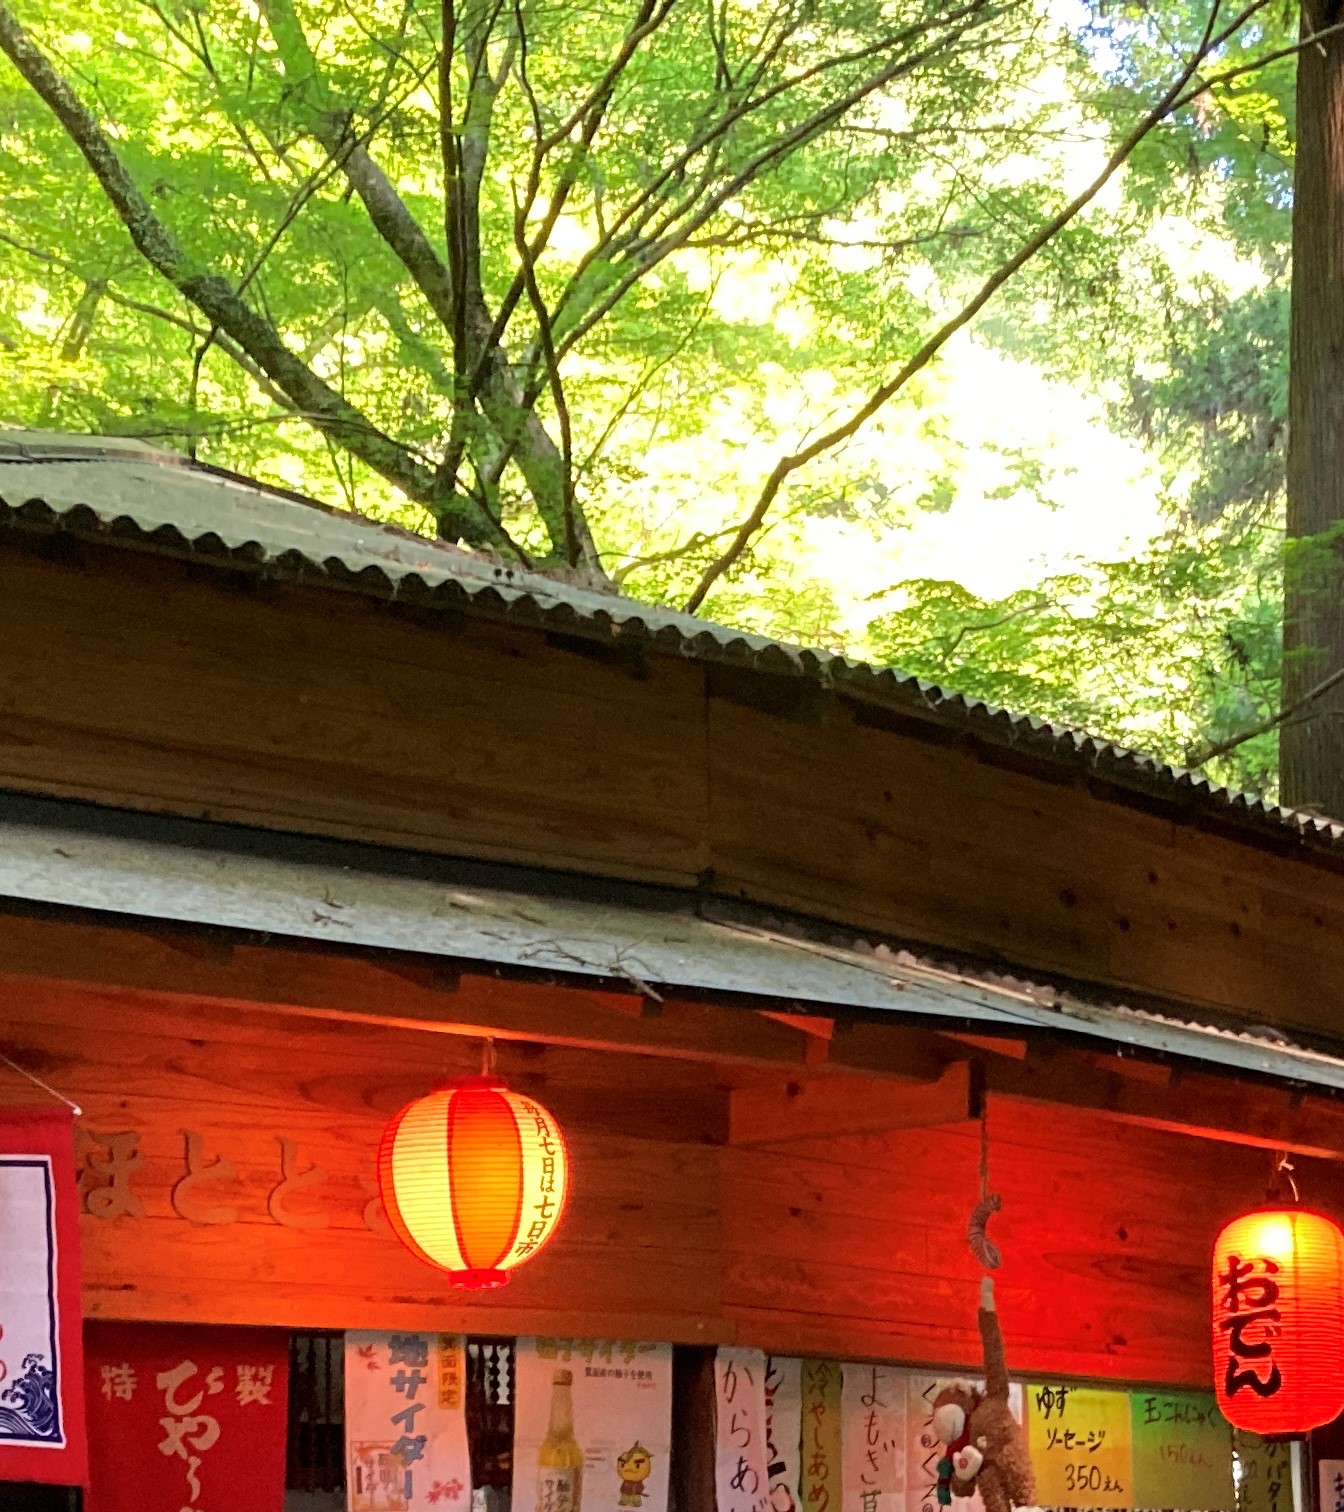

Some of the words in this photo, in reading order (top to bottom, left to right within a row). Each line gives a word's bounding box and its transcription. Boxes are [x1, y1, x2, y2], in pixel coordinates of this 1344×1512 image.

[1217, 1255, 1282, 1399] おでん
[1036, 1385, 1077, 1419] ゆず
[1046, 1428, 1106, 1453] ソーセージ
[1064, 1463, 1124, 1494] 350えん
